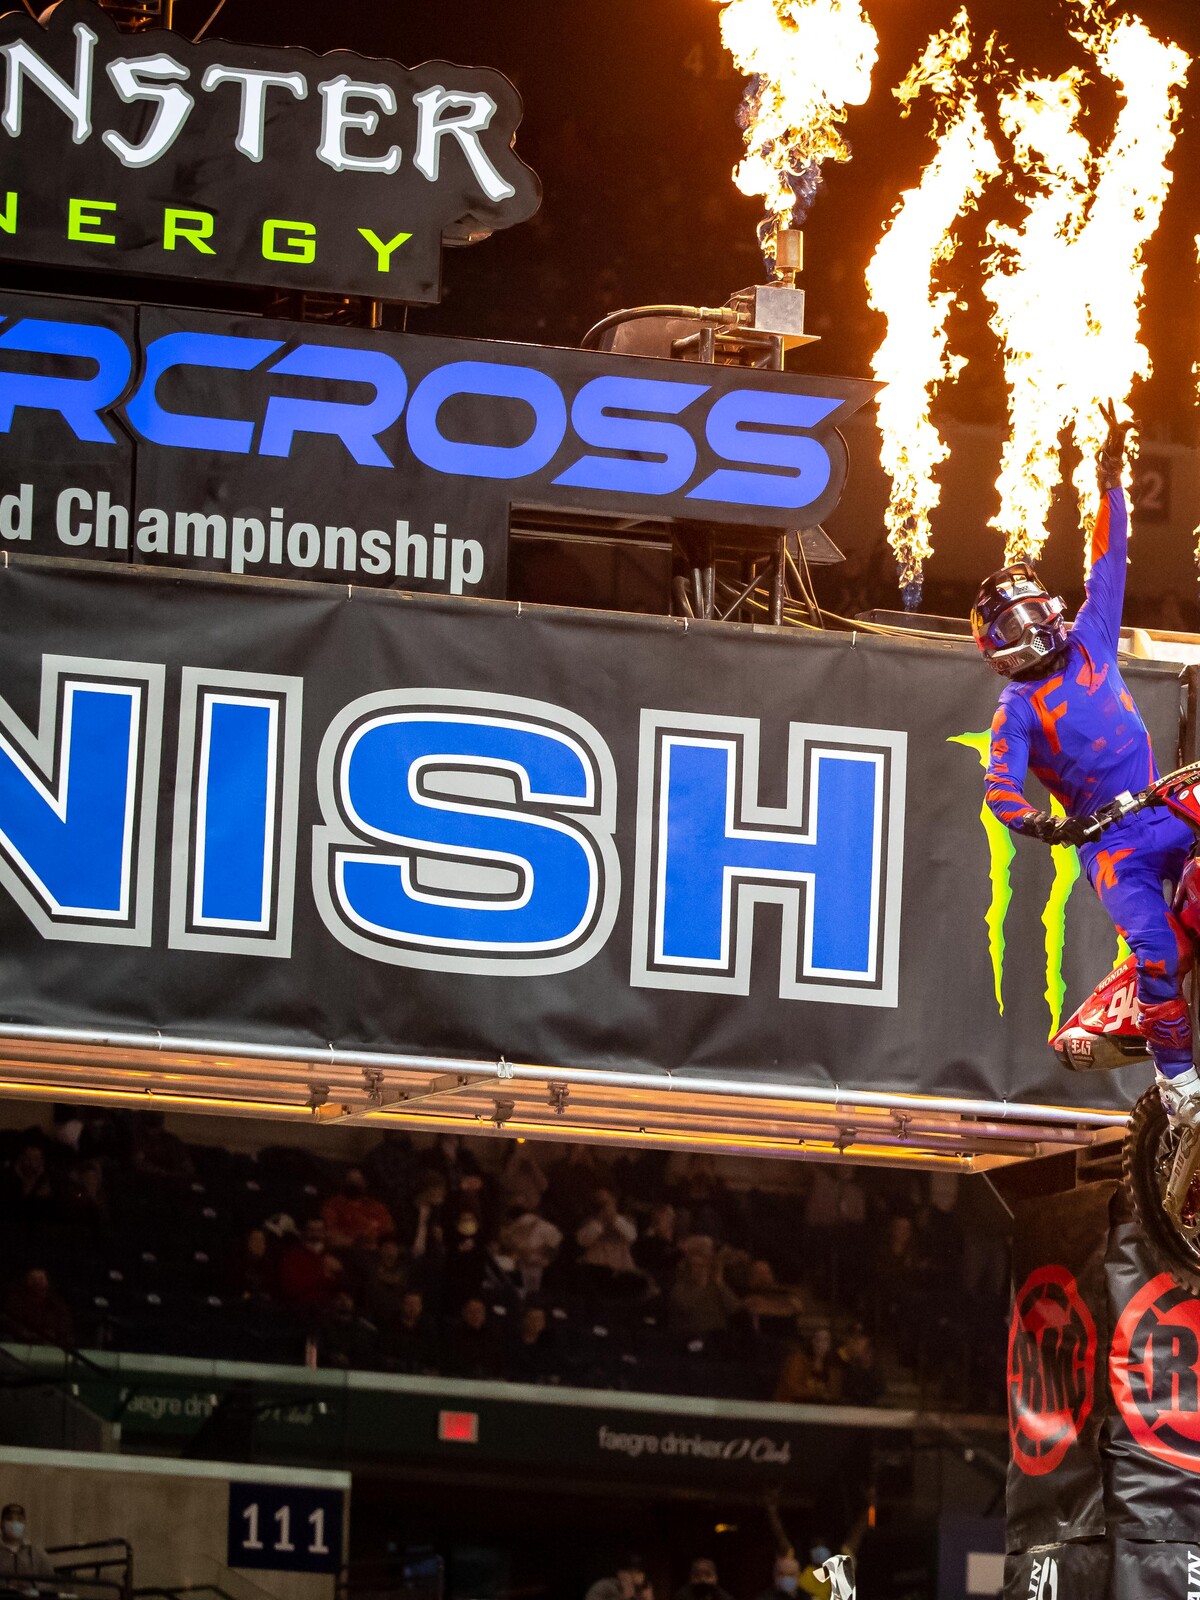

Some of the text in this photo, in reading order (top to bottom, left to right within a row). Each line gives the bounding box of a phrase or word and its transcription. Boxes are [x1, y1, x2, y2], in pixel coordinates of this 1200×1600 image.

[1, 21, 516, 202] NSTER
[55, 487, 485, 595] Championship
[0, 654, 907, 1007] NISH
[1098, 964, 1128, 991] HONDA
[1102, 981, 1140, 1032] 94
[241, 1502, 331, 1556] 111
